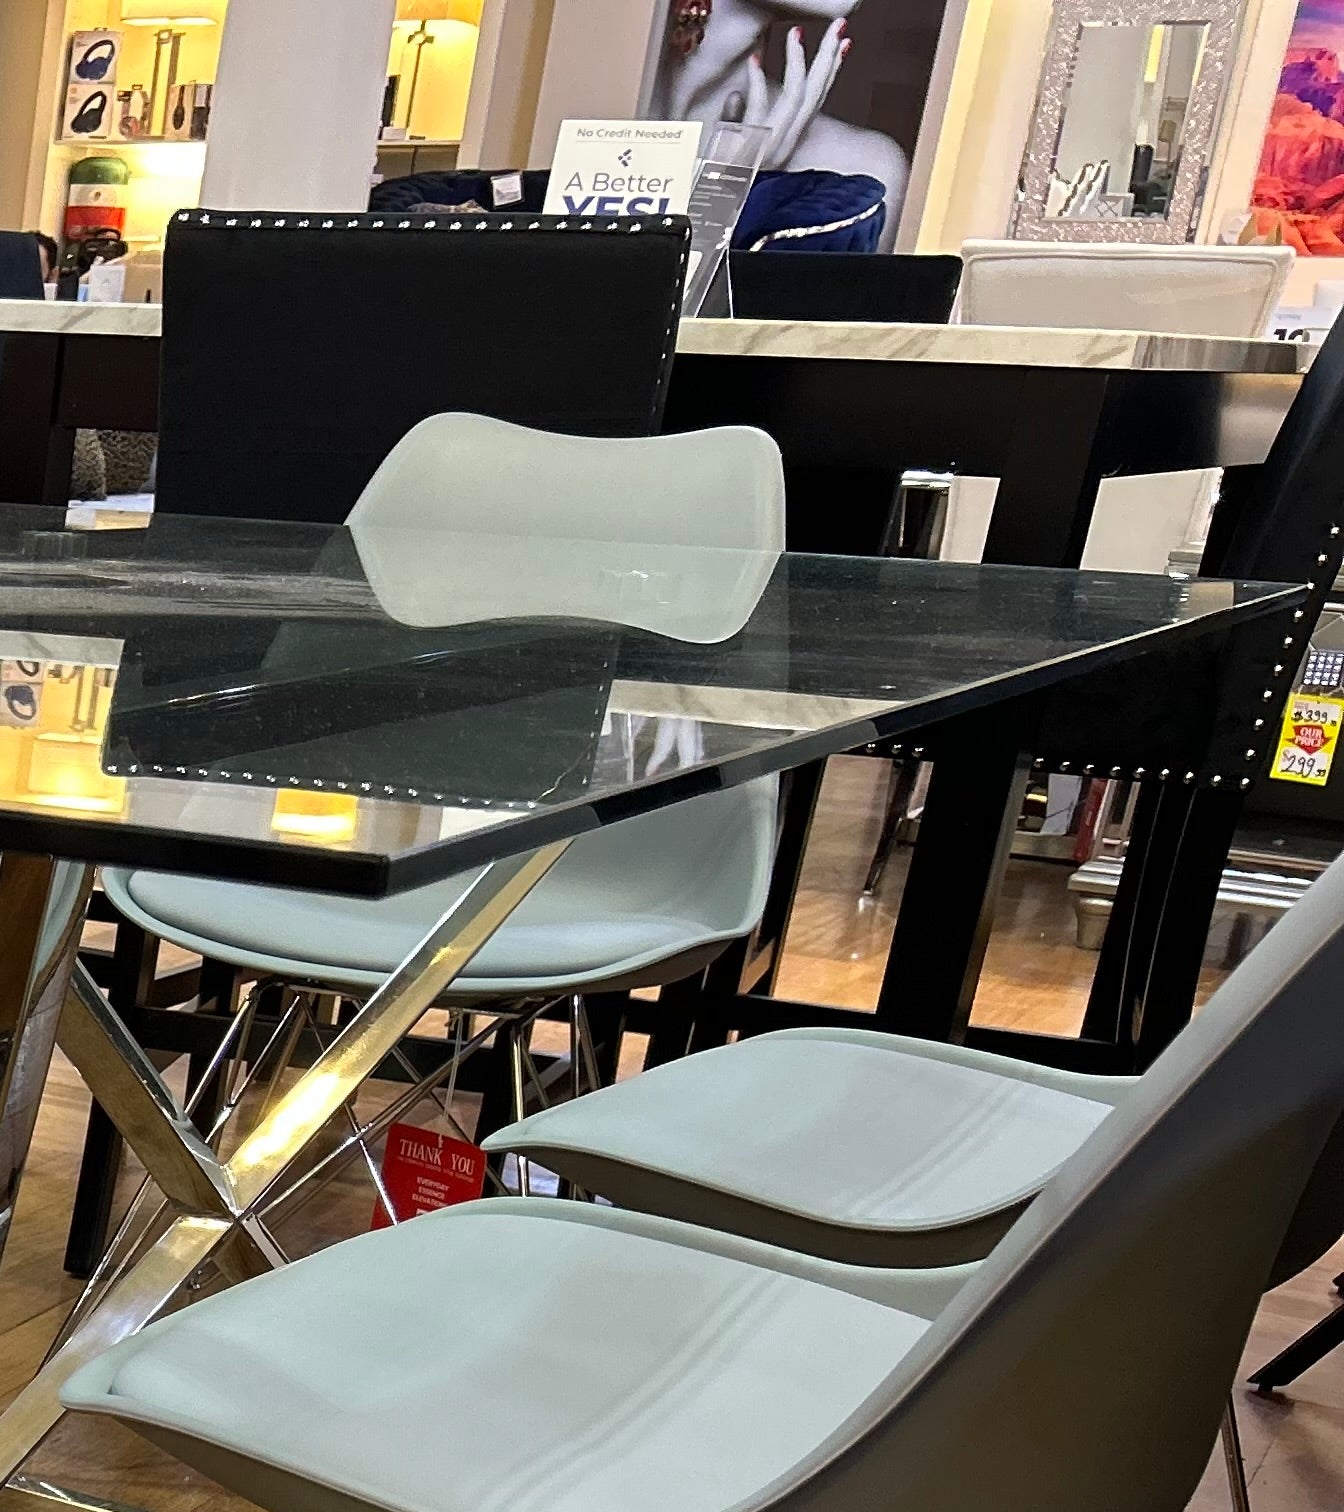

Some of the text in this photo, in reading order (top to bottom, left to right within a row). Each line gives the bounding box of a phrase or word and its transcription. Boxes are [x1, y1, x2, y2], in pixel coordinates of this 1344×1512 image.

[577, 127, 683, 139] No Credit Needed
[564, 172, 673, 193] A Better
[1299, 727, 1322, 738] OUR
[1294, 735, 1324, 747] PRICE
[399, 1138, 443, 1166] THANK
[451, 1153, 476, 1176] YOU
